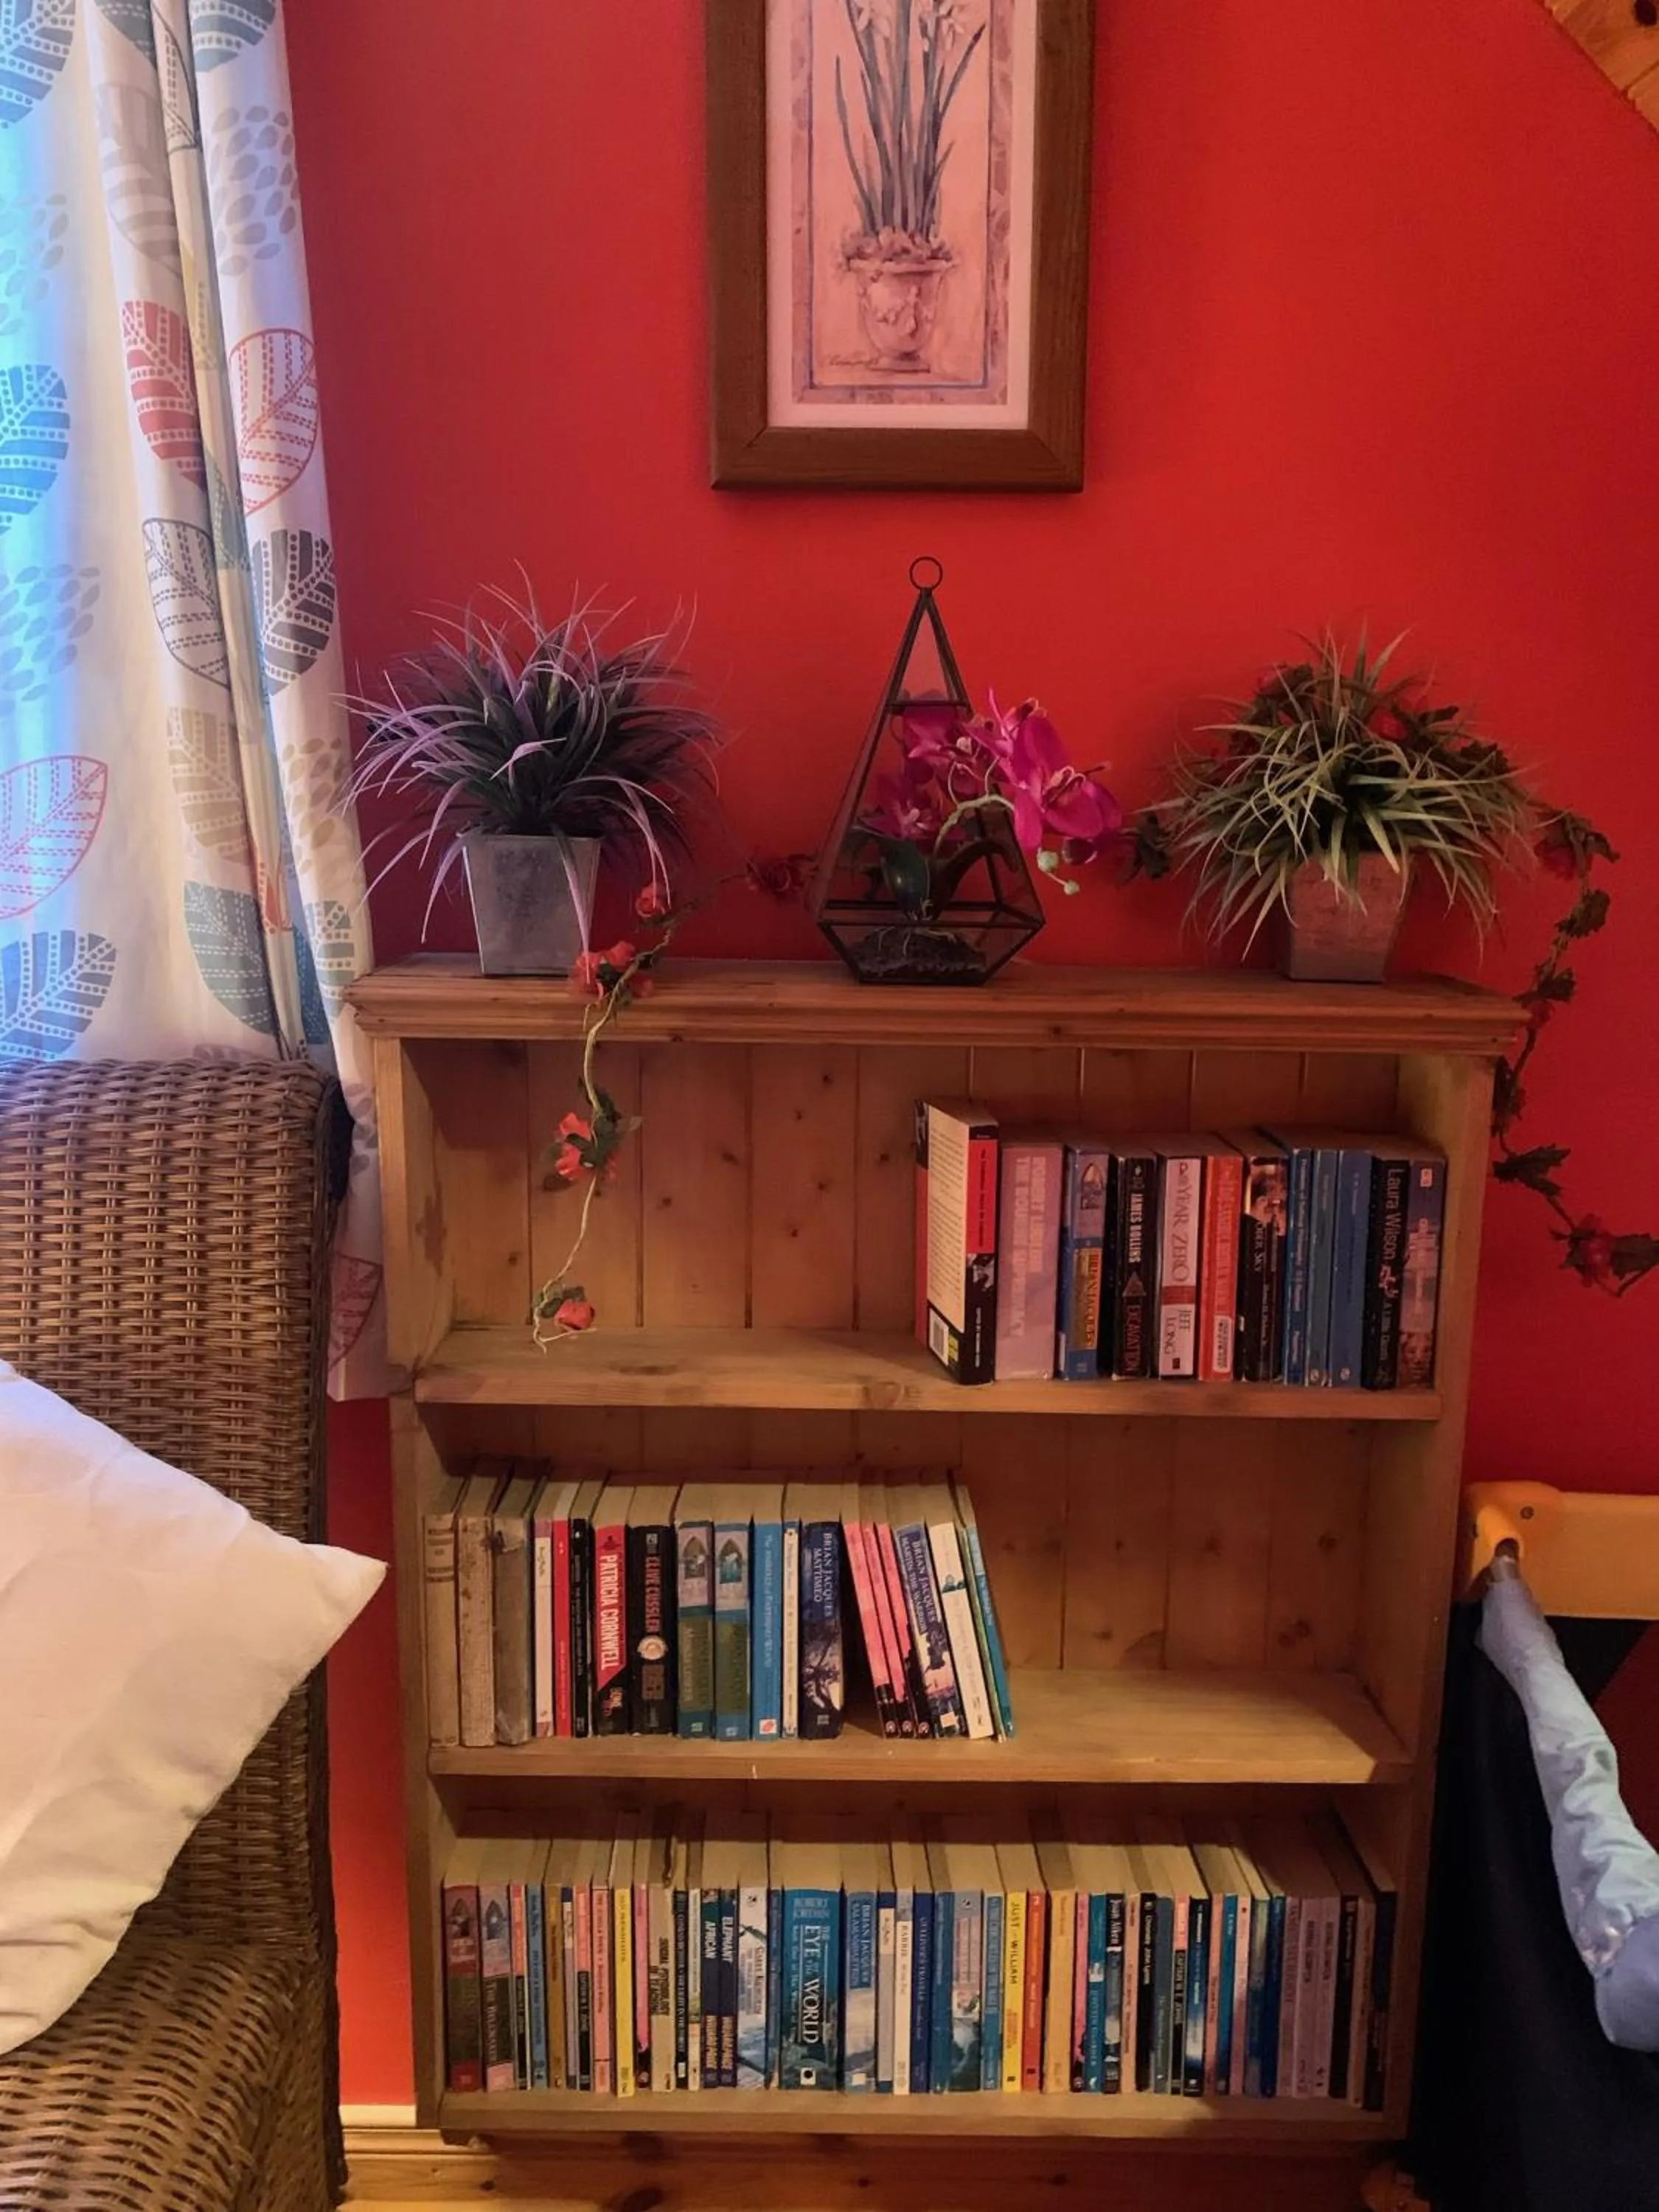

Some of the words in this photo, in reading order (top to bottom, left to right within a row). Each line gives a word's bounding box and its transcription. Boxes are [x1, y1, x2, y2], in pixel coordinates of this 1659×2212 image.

[1015, 1156, 1031, 1183] THE
[1032, 1156, 1046, 1213] ROBERT
[1385, 1168, 1405, 1209] Laura
[1130, 1194, 1144, 1223] JAMES
[1173, 1185, 1192, 1227] YEAR
[1128, 1225, 1142, 1263] ROLLINS
[1382, 1213, 1402, 1260] Wilson
[1172, 1233, 1191, 1282] ZERO
[1164, 1316, 1177, 1355] LONG
[1179, 1309, 1192, 1332] JEFF
[822, 1533, 833, 1567] BRIAN
[911, 1540, 925, 1575] BRIAN
[600, 1554, 619, 1606] PATRICIA
[645, 1557, 661, 1585] CLIVE
[813, 1548, 824, 1603] MATTIMEO
[645, 1587, 661, 1632] CUSSLER
[821, 1569, 833, 1618] JACQUES
[917, 1576, 936, 1623] JACQUES
[600, 1610, 619, 1671] CORNWELL
[861, 1904, 871, 1936] BRIAN
[1011, 1902, 1020, 1929] JUST
[1110, 1899, 1122, 1919] Joan
[704, 1921, 717, 1959] AFRICAN
[722, 1916, 734, 1964] ELEPHANT
[804, 1925, 821, 1958] EYE
[1111, 1921, 1122, 1944] Aiken
[860, 1938, 871, 1983] JACQUES
[1009, 1940, 1018, 1985] WILLIAM
[803, 1978, 821, 2044] WORLD
